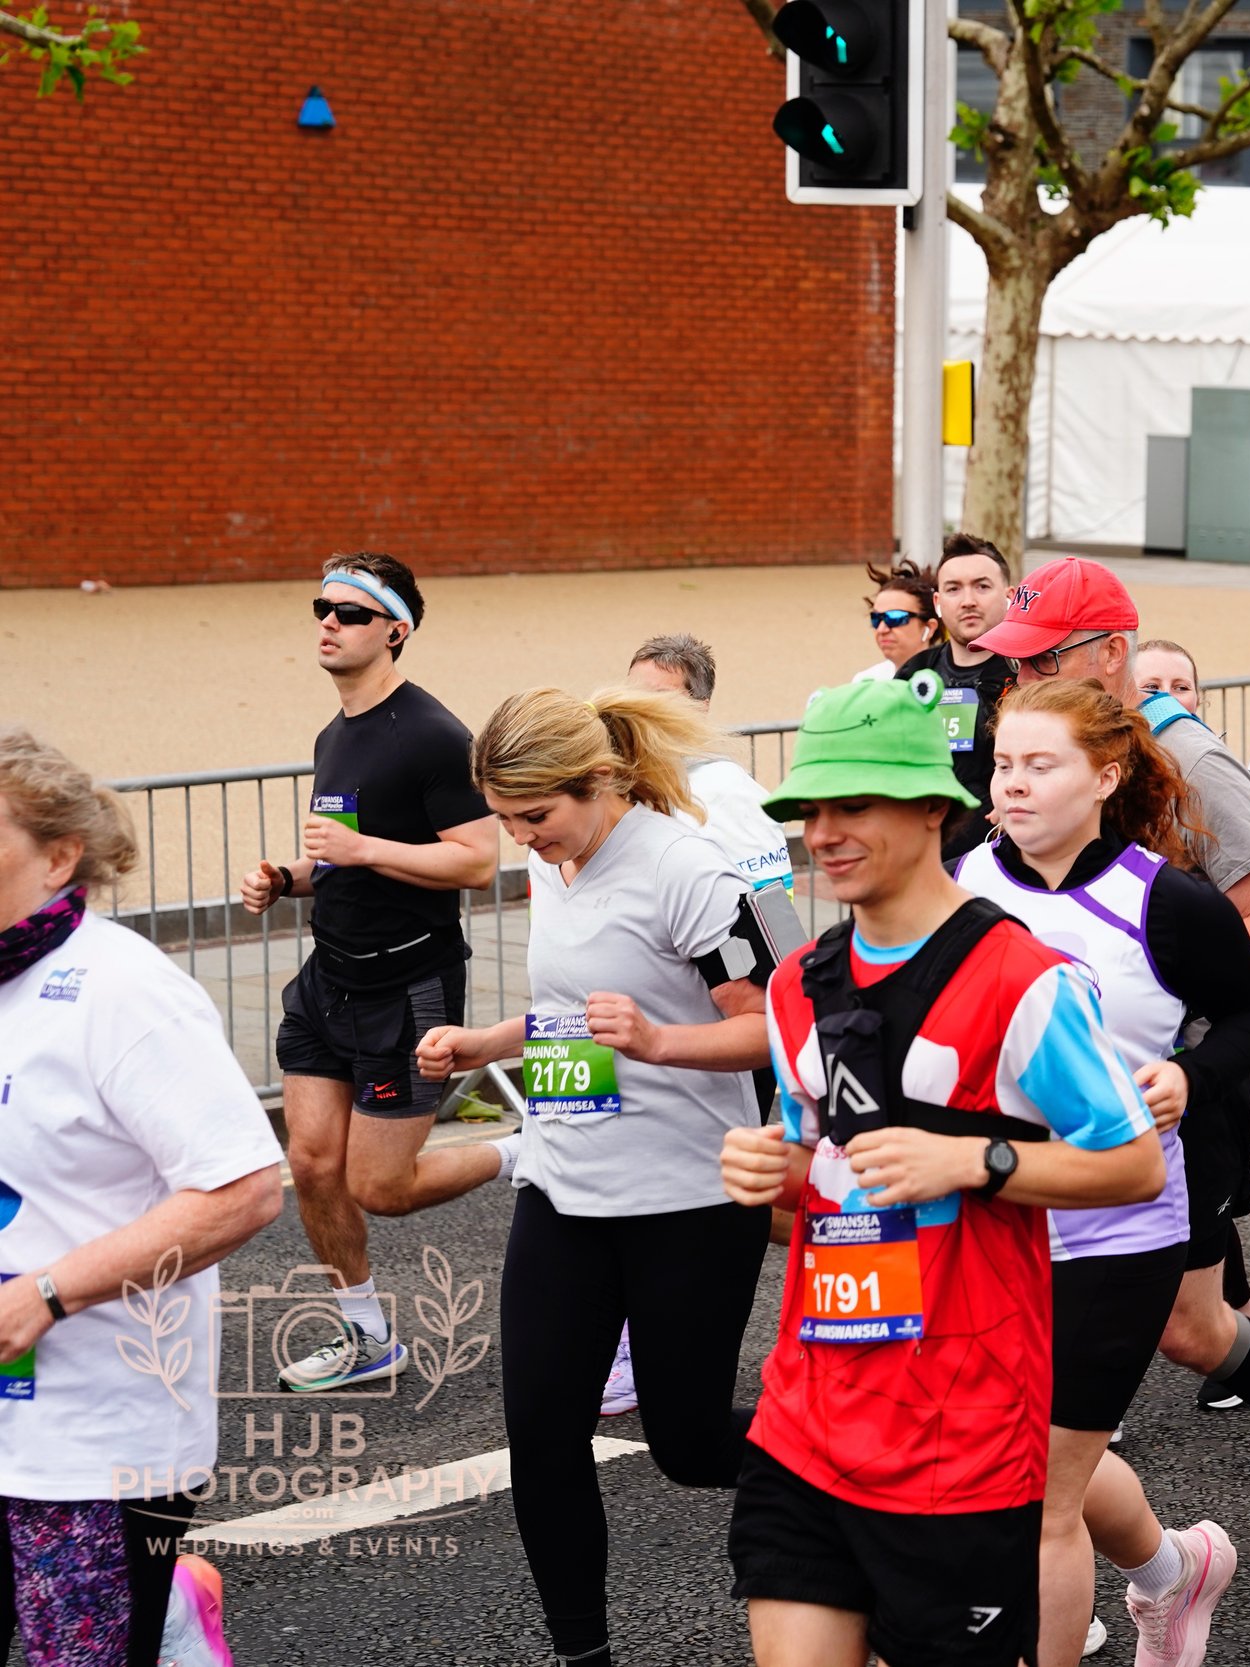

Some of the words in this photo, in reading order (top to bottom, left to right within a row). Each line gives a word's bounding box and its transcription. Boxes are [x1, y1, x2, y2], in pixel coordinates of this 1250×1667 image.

[1012, 585, 1040, 612] NY
[532, 1060, 591, 1092] 2179
[376, 1090, 398, 1099] NIKE
[826, 1214, 880, 1228] SWANSEA
[813, 1271, 881, 1313] 1791
